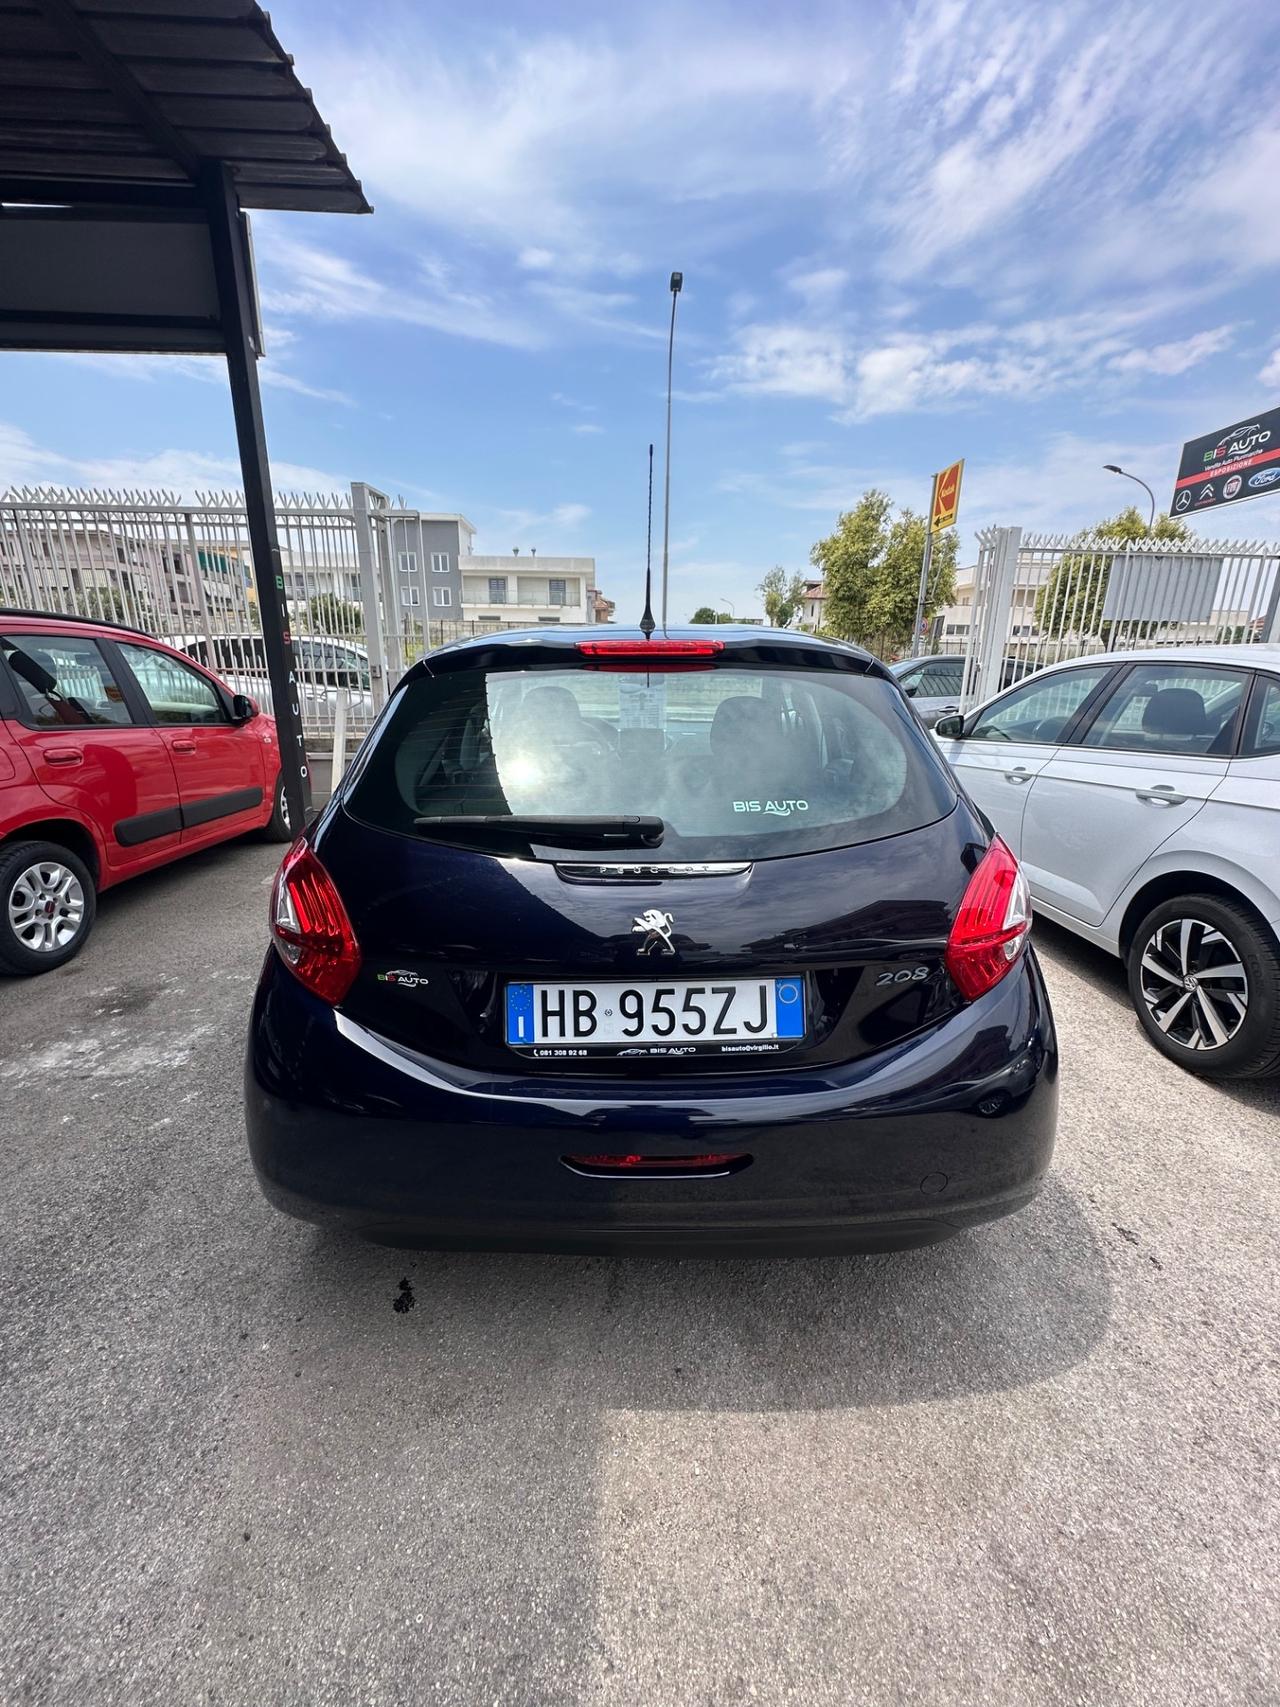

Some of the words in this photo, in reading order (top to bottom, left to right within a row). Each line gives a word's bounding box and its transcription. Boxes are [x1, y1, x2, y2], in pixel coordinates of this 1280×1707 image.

[1204, 446, 1226, 461] BIS
[1228, 430, 1271, 454] AUTO
[732, 800, 761, 812] BIS
[764, 799, 809, 812] AUTO
[377, 974, 397, 982] BIS
[398, 976, 429, 985] AUTO
[876, 966, 929, 986] 208
[540, 989, 597, 1038] HB
[619, 985, 768, 1037] 955ZJ
[667, 1046, 696, 1055] AUTO
